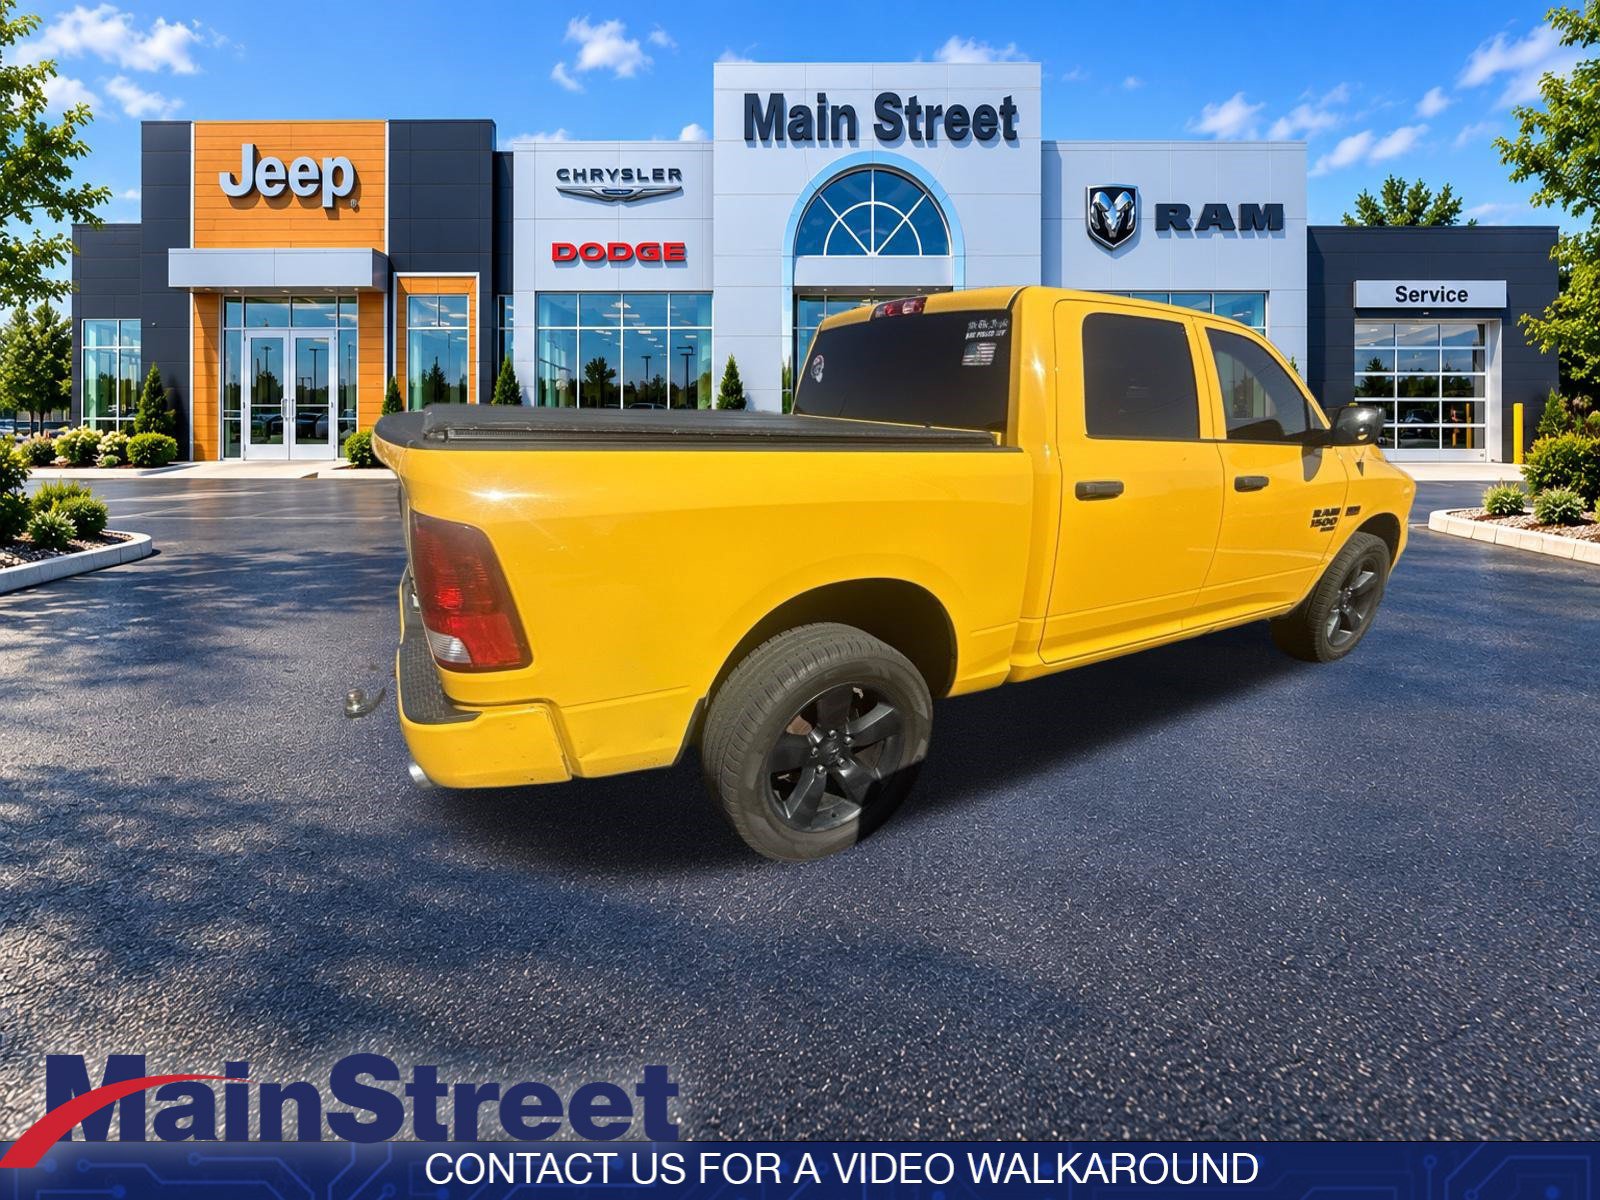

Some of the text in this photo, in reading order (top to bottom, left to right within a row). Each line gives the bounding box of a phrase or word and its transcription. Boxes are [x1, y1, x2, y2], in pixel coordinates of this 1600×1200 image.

[744, 91, 1018, 141] Main Street
[219, 143, 354, 208] Jeep
[556, 168, 682, 181] CHRYSLER
[1155, 203, 1284, 231] RAM
[552, 242, 686, 261] DODGE
[1395, 285, 1469, 303] Service
[1312, 507, 1341, 518] RAM
[1310, 516, 1338, 528] 1500
